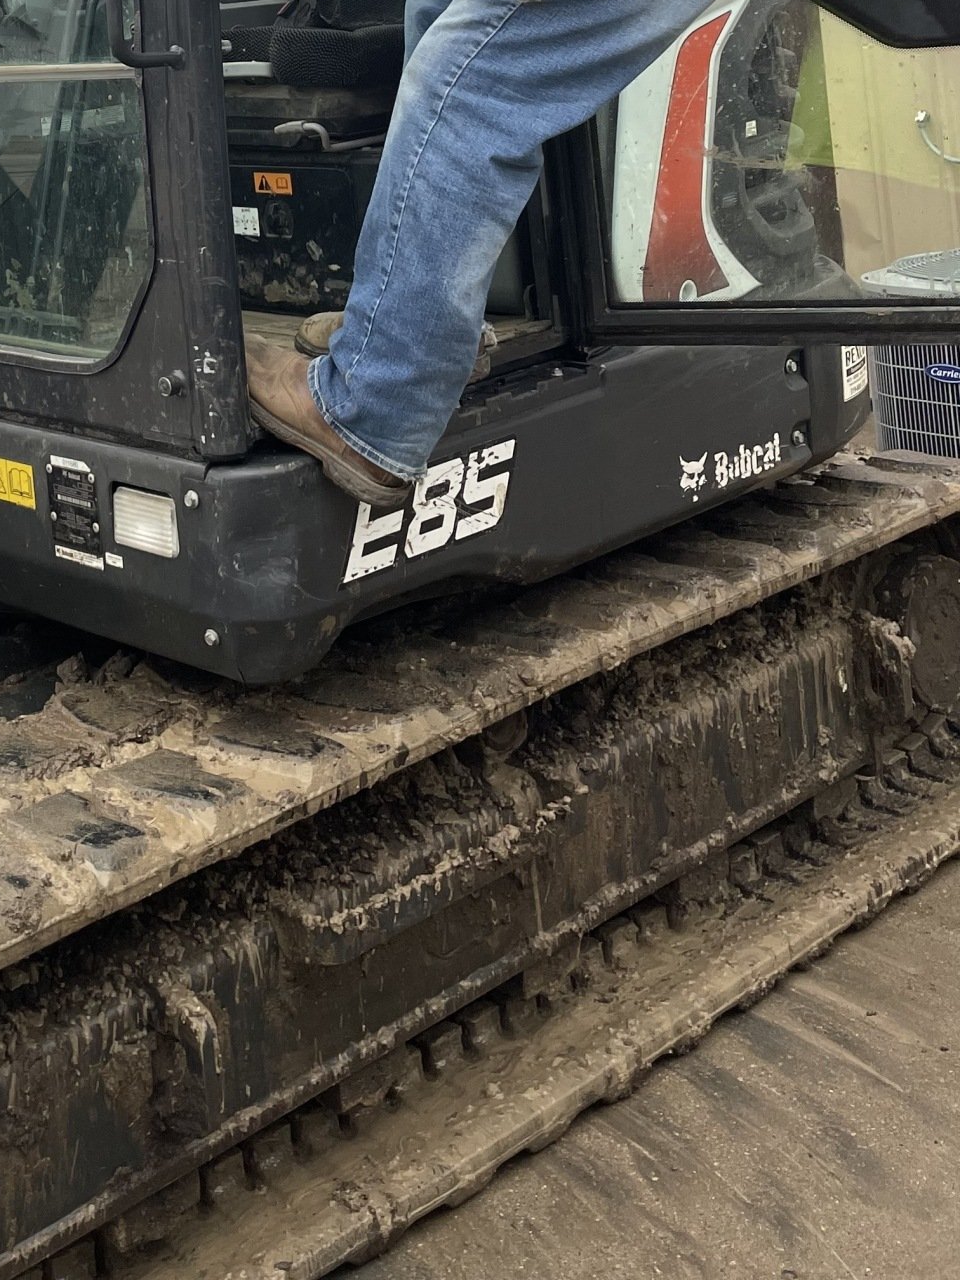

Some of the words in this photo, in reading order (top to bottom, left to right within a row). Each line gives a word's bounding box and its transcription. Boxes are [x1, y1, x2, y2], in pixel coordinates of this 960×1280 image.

[930, 367, 960, 379] Carrie
[714, 432, 781, 488] Bobcat
[343, 439, 516, 584] E85
